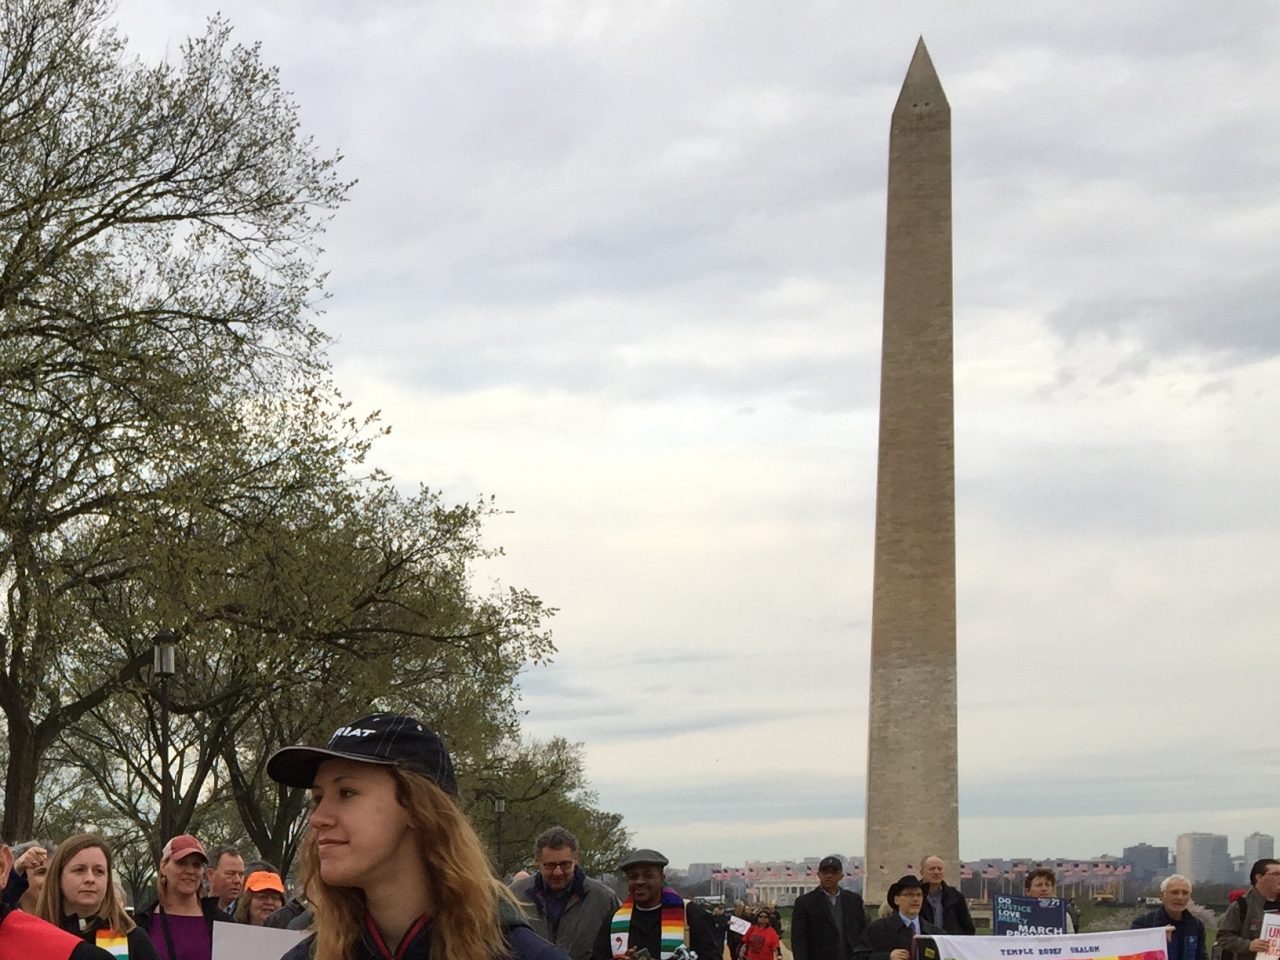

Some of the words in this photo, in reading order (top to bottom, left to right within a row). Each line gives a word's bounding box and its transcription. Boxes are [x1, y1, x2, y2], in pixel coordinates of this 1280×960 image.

[998, 897, 1011, 905] DO
[998, 903, 1032, 913] JUSTICE
[998, 909, 1021, 918] LOVE
[1018, 924, 1063, 936] MARCH
